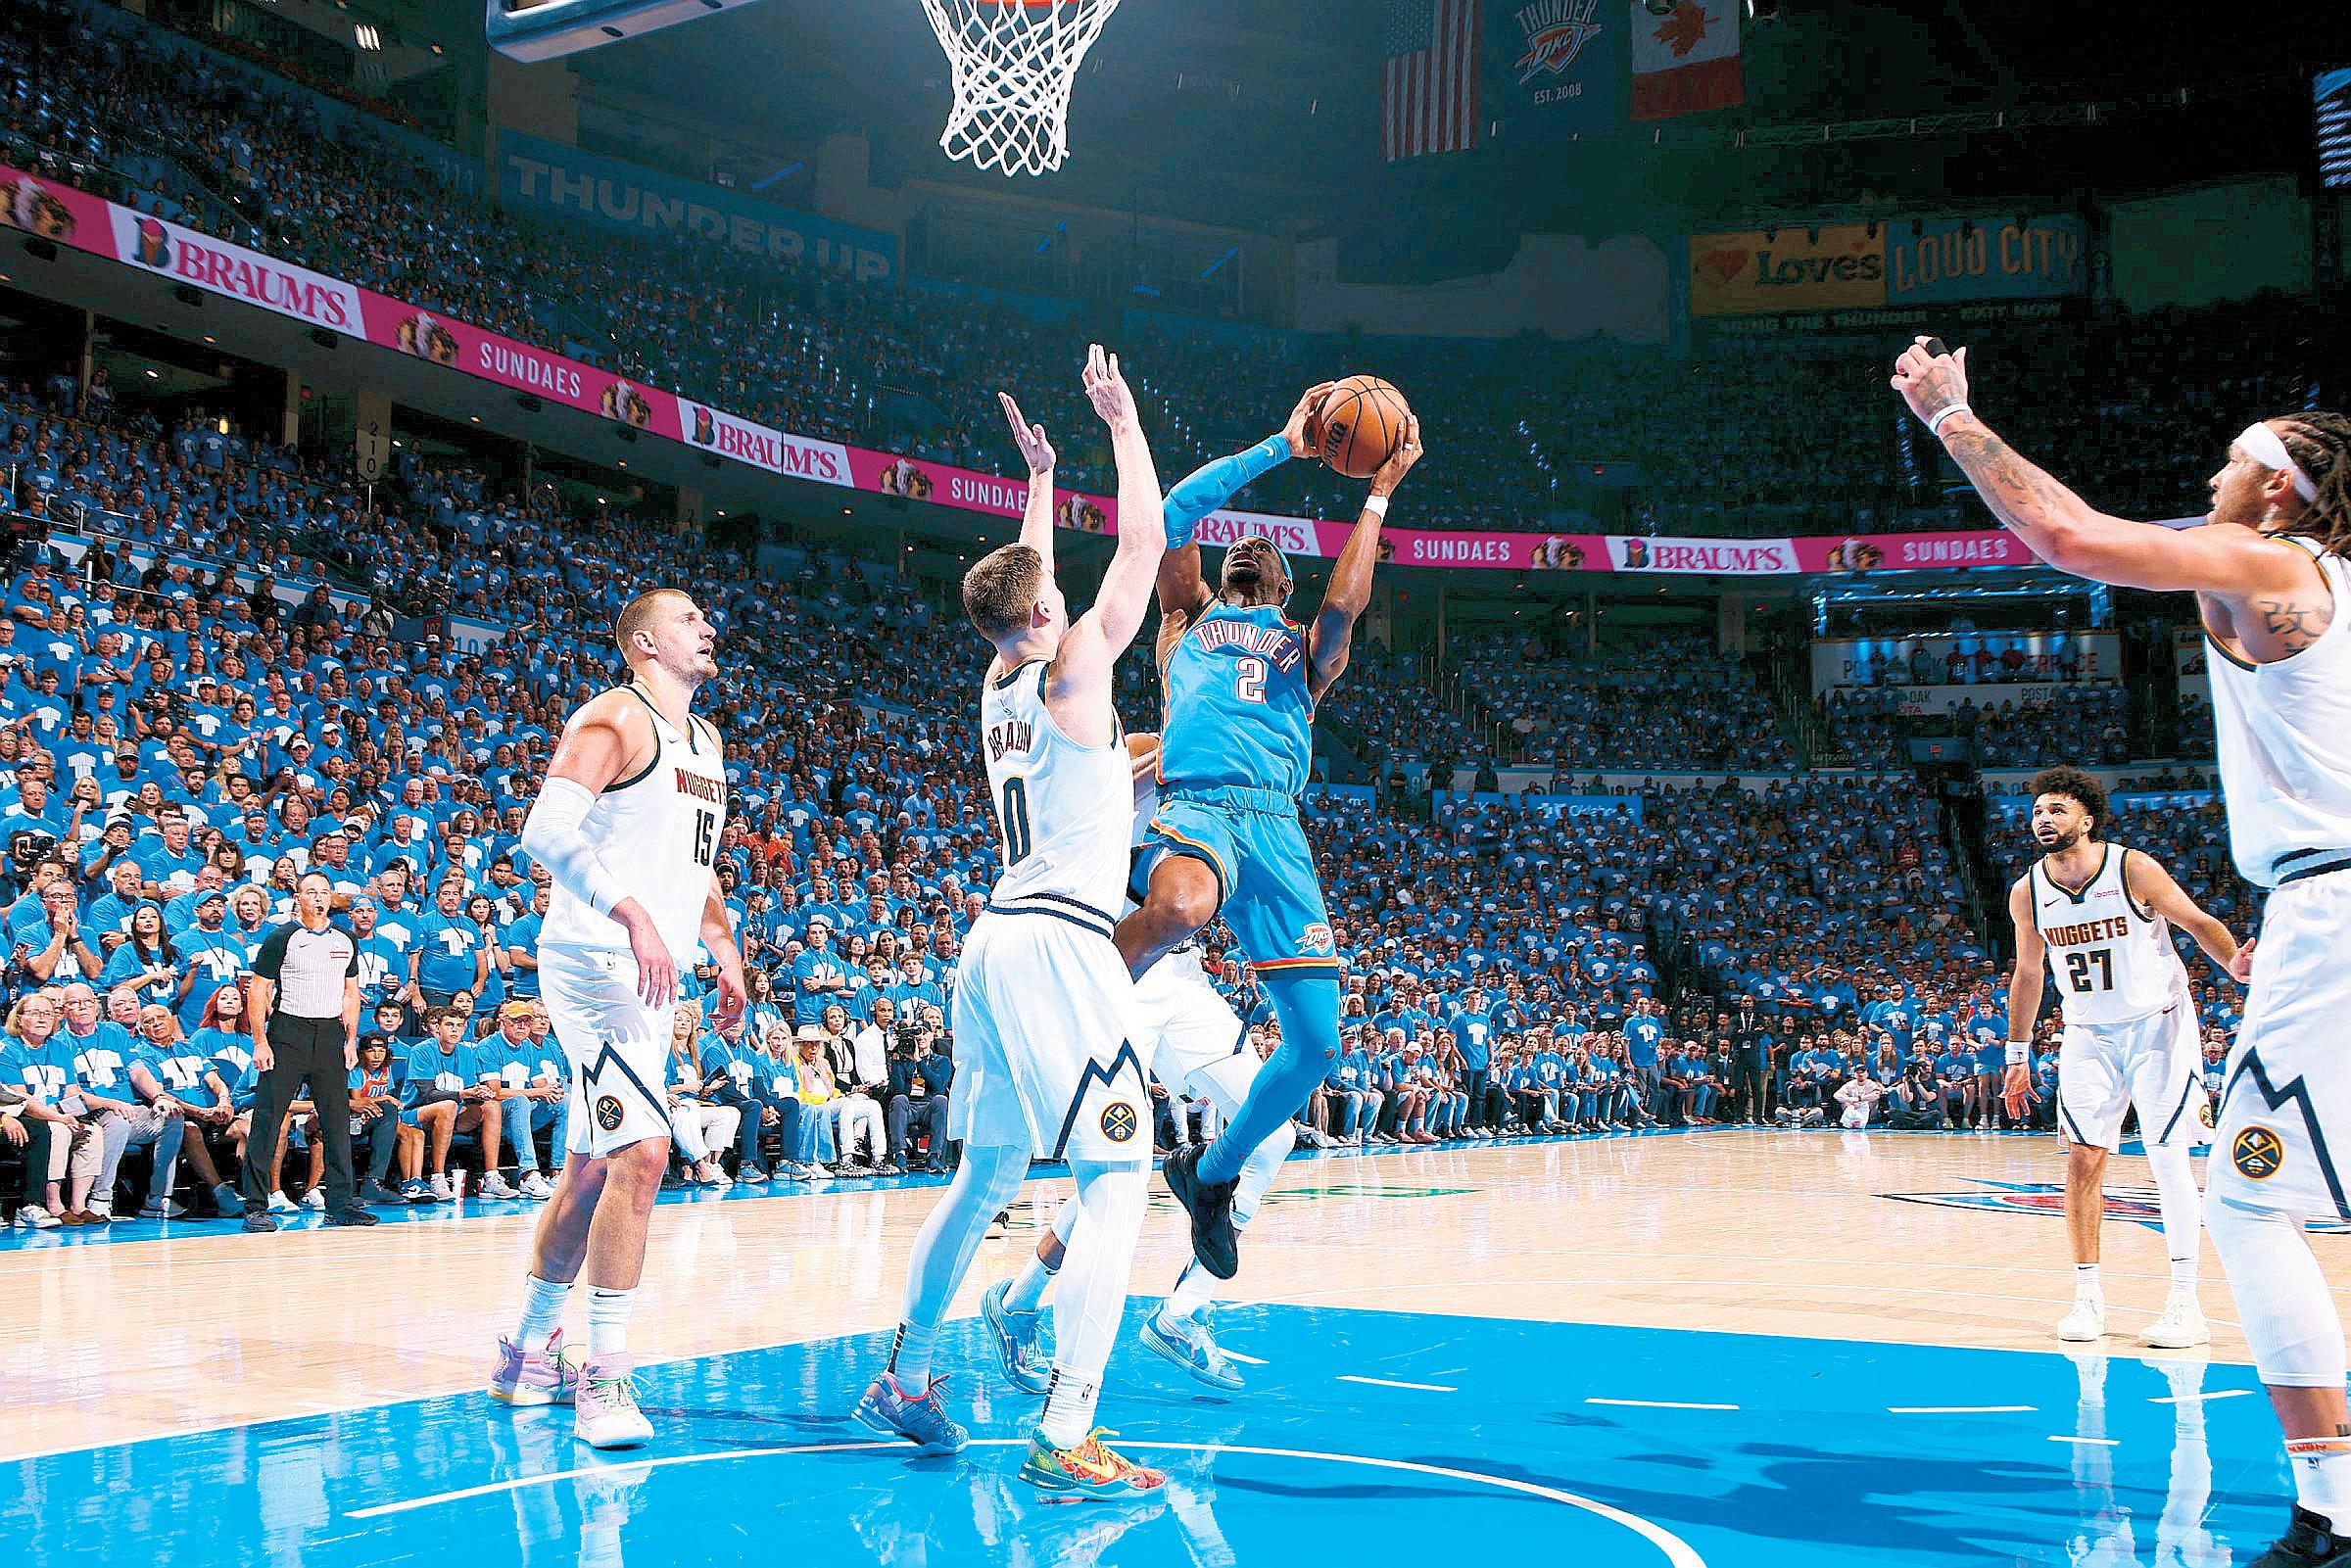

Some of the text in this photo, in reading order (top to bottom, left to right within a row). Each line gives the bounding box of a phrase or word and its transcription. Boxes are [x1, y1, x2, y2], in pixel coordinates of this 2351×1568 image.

[1534, 80, 1583, 102] EST. 2008
[508, 155, 804, 257] THUNDER
[815, 238, 890, 282] UP
[175, 238, 348, 327] BRAUM'S
[1895, 224, 2078, 294] LOUD CITY
[480, 342, 582, 399] SUNDAES
[717, 420, 839, 479] BRAUM'S
[951, 477, 1028, 512] SUNDAE
[1413, 538, 1511, 561] SUNDAES
[1653, 546, 1783, 572] BRAUM'S
[1902, 538, 2009, 564] SUNDAES
[1193, 619, 1301, 674] THUNDER
[1237, 657, 1266, 704] 2
[675, 767, 727, 807] NUGGETS
[695, 808, 715, 867] 15
[1003, 775, 1032, 867] 0
[2043, 916, 2129, 947] NUGGETS
[2066, 948, 2114, 993] 27
